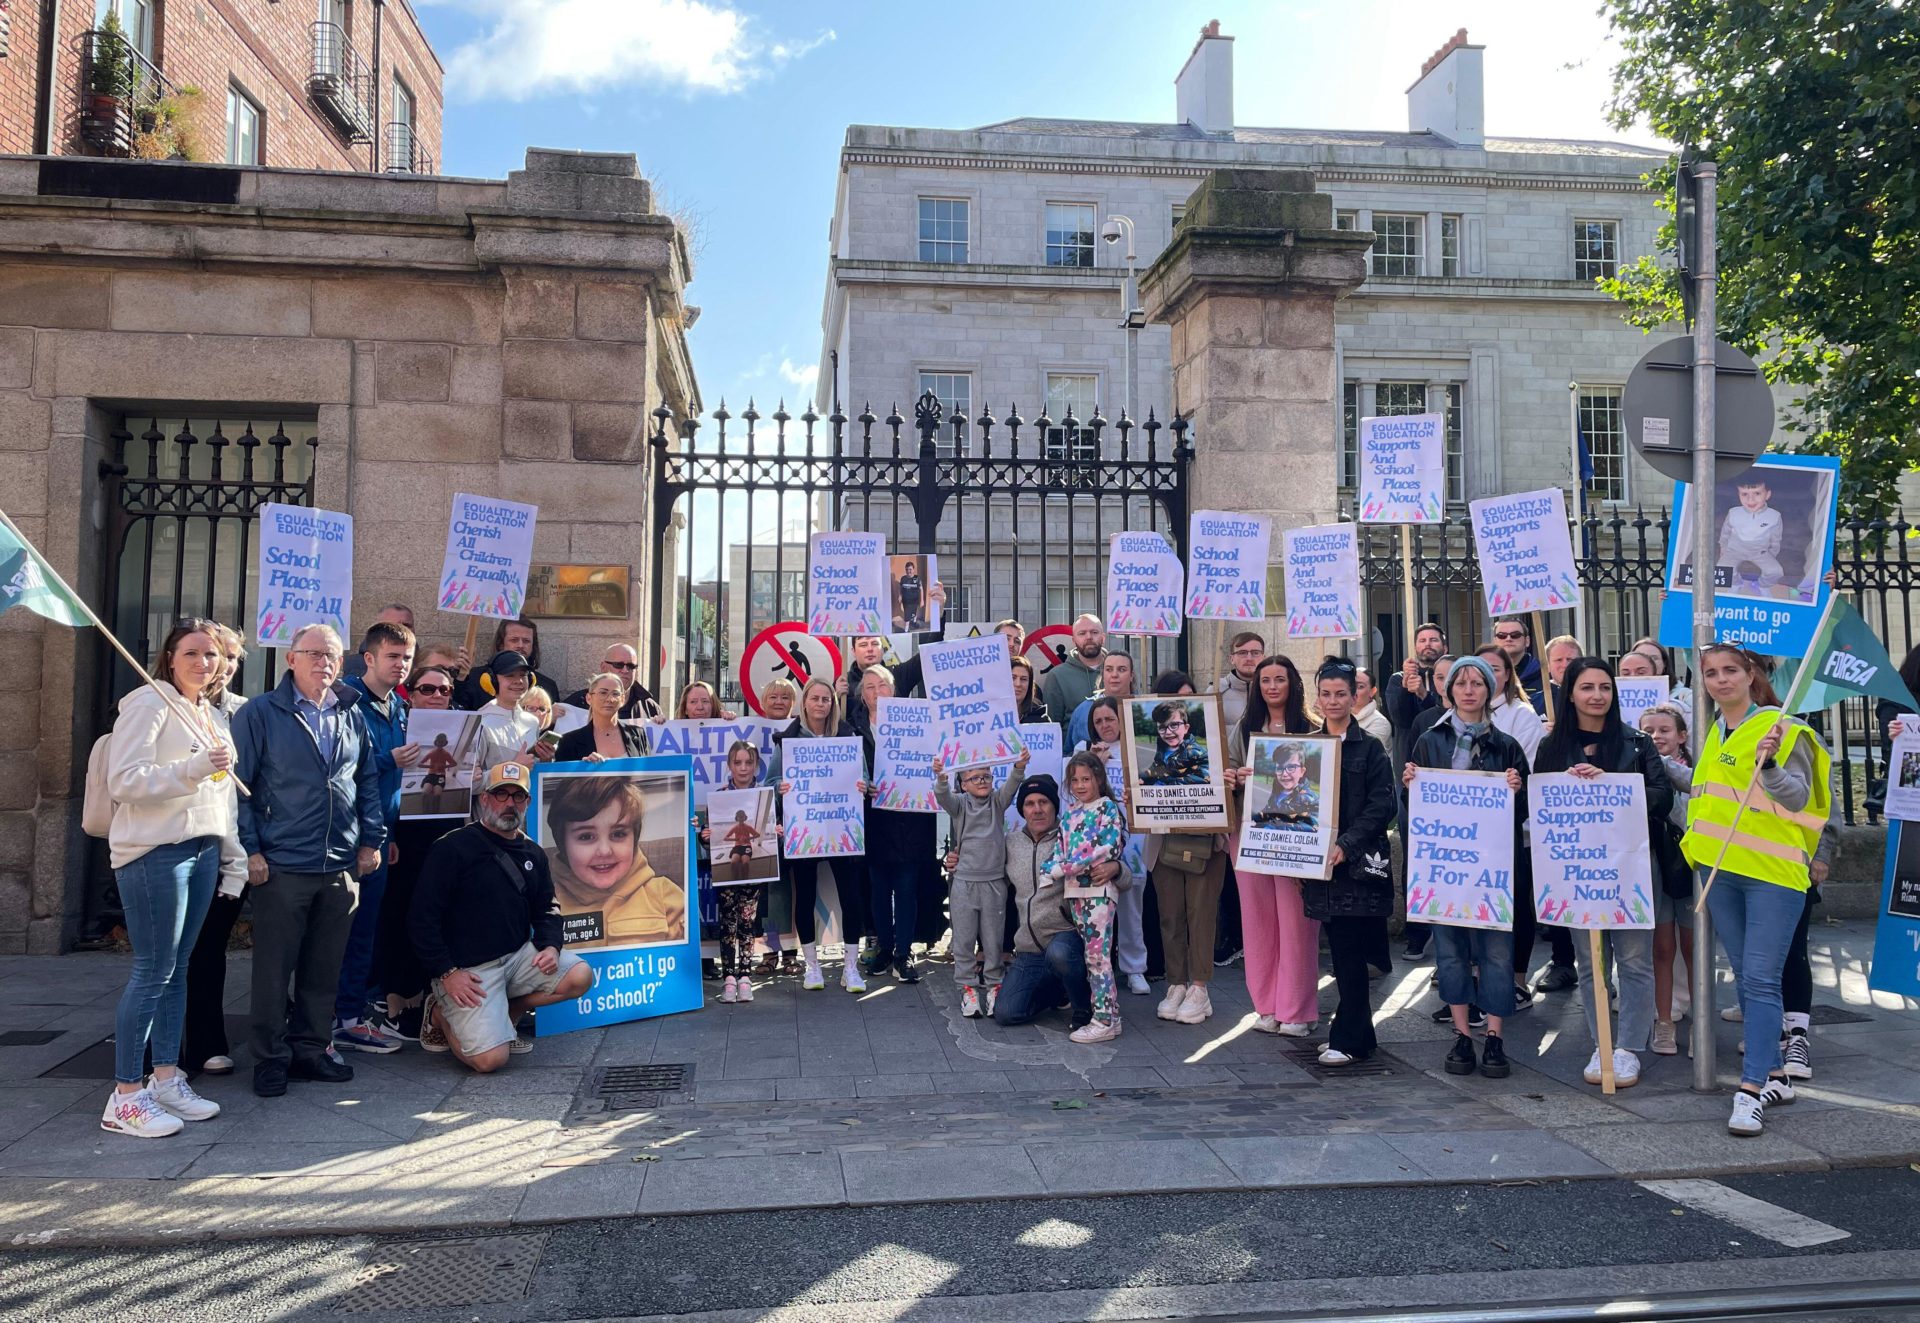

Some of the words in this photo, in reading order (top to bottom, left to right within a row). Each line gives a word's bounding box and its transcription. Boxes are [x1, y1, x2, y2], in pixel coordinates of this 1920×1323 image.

[1372, 422, 1421, 432] EQUALITY
[1423, 421, 1435, 430] IN
[1373, 430, 1434, 440] EDUCATION
[1367, 439, 1421, 453] Supports
[1370, 453, 1396, 464] And
[1374, 463, 1415, 475] School
[1382, 477, 1421, 490] Places
[1387, 491, 1422, 503] Now!
[464, 501, 515, 518] EQUALITY
[516, 510, 528, 520] IN
[1482, 500, 1536, 517] EQUALITY
[1539, 497, 1552, 507] IN
[275, 513, 331, 530] EQUALITY
[333, 522, 345, 533] IN
[464, 511, 526, 528] EDUCATION
[1485, 506, 1552, 525] EDUCATION
[278, 523, 343, 542] EDUCATION
[453, 521, 502, 540] Cherish
[1200, 520, 1245, 530] EQUALITY
[1248, 522, 1260, 530] IN
[1480, 519, 1540, 539] Supports
[1201, 528, 1258, 538] EDUCATION
[1294, 533, 1337, 546] EQUALITY
[1339, 533, 1351, 541] IN
[456, 535, 476, 549] All
[820, 540, 863, 549] EQUALITY
[1120, 537, 1164, 546] EQUALITY
[1296, 541, 1349, 553] EDUCATION
[1487, 536, 1516, 553] And
[266, 546, 321, 569] School
[459, 549, 513, 567] Children
[821, 547, 875, 556] EDUCATION
[1193, 546, 1240, 561] School
[1493, 545, 1539, 564] School
[1289, 552, 1338, 567] Supports
[465, 565, 517, 585] Equally!
[813, 565, 858, 579] School
[1113, 562, 1158, 576] School
[1196, 563, 1240, 578] Places
[1293, 566, 1315, 578] And
[1505, 562, 1549, 578] Places
[268, 569, 321, 592] Places
[816, 581, 859, 595] Places
[1116, 578, 1159, 593] Places
[1205, 579, 1232, 594] For
[1236, 580, 1260, 595] All
[1296, 577, 1332, 589] School
[1515, 574, 1552, 592] Now!
[280, 591, 313, 611] For
[316, 596, 342, 615] All
[825, 596, 852, 611] For
[856, 596, 877, 610] All
[1125, 594, 1151, 608] For
[1155, 595, 1177, 609] All
[1303, 592, 1338, 604] Places
[1309, 604, 1340, 617] Now!
[1714, 605, 1749, 620] want
[1753, 606, 1767, 622] to
[1772, 611, 1790, 627] go
[931, 645, 985, 664] EQUALITY
[987, 643, 1000, 654] IN
[934, 652, 1000, 672] EDUCATION
[930, 677, 984, 701] School
[1644, 689, 1658, 698] IN
[887, 705, 930, 715] EQUALIT
[938, 700, 990, 721] Places
[878, 723, 924, 738] Cherish
[953, 719, 985, 738] For
[990, 710, 1014, 731] All
[883, 737, 901, 749] All
[1043, 733, 1055, 741] IN
[793, 745, 846, 756] EQUALITY
[846, 744, 858, 753] IN
[795, 753, 857, 764] EDUCATION
[785, 765, 833, 779] Cherish
[992, 766, 1008, 778] All
[792, 780, 810, 792] All
[1140, 788, 1154, 798] THIS
[1156, 788, 1162, 798] IS
[1164, 788, 1187, 798] DANIEL
[1189, 787, 1216, 797] COLGAN.
[1420, 782, 1488, 797] EQUALITY
[1491, 787, 1508, 799] IN
[1541, 784, 1612, 796] EQUALITY
[1615, 784, 1633, 796] IN
[796, 792, 848, 805] Children
[1422, 793, 1506, 809] EDUCATION
[1544, 795, 1631, 808] EDUCATION
[805, 806, 856, 823] Equally!
[1537, 808, 1614, 828] Supports
[1410, 817, 1479, 840] School
[1542, 828, 1580, 844] And
[1249, 831, 1262, 841] THIS
[1263, 832, 1269, 841] IS
[1270, 833, 1292, 844] DANIEL
[1294, 834, 1319, 846] COLGAN.
[1414, 840, 1480, 864] Places
[1550, 844, 1607, 861] School
[1364, 866, 1388, 878] adidas
[1427, 865, 1469, 886] For
[1474, 868, 1509, 889] All
[1563, 864, 1619, 881] Places
[1573, 884, 1621, 901] Now!
[1902, 880, 1912, 894] My
[567, 918, 587, 928] name
[588, 916, 595, 926] is
[580, 930, 593, 940] age
[594, 927, 599, 937] 6
[649, 954, 653, 974] I
[658, 956, 676, 978] go
[578, 996, 592, 1015] to
